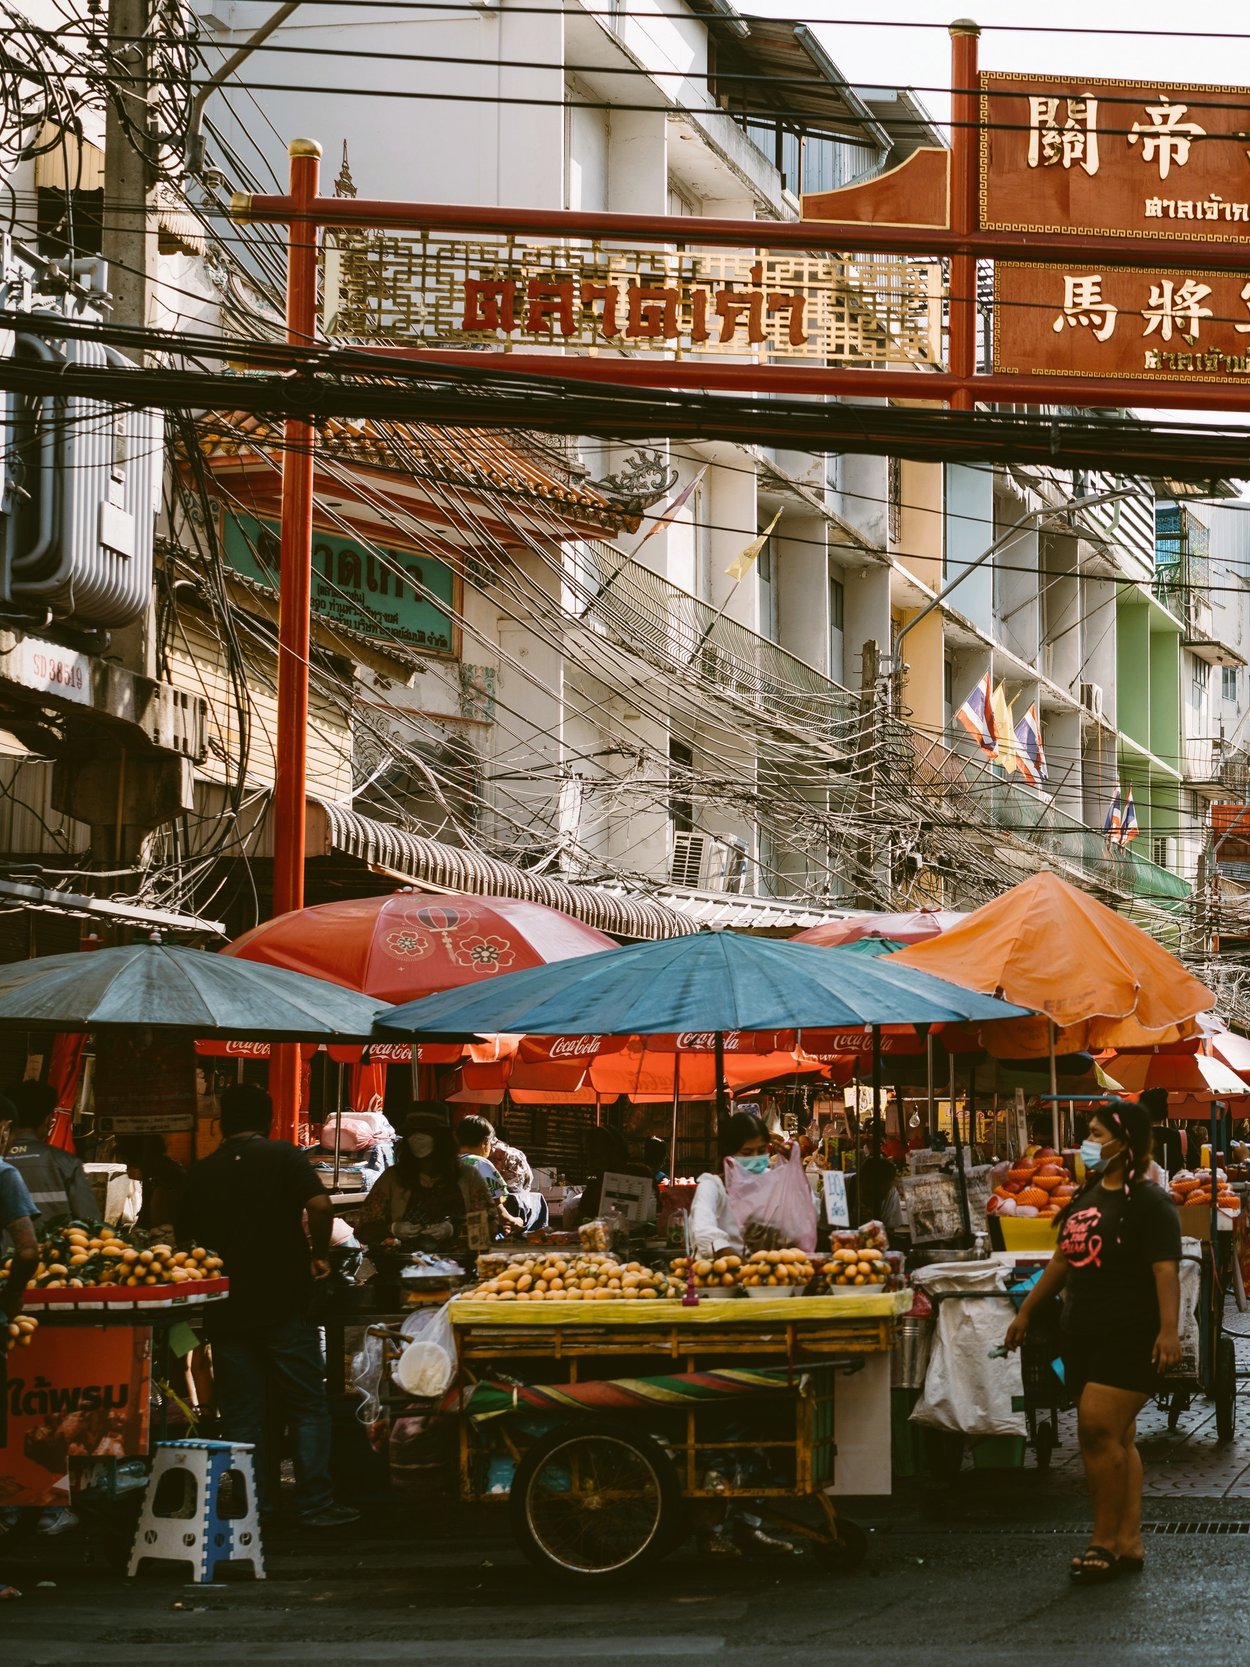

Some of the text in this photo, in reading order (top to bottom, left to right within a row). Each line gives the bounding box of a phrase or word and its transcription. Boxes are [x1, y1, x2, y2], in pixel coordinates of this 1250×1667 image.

[462, 266, 809, 347] ตลาดเก่า
[256, 530, 424, 602] ตาดเก่า
[33, 654, 83, 690] SD 38519
[549, 1034, 601, 1058] Coca-Cola
